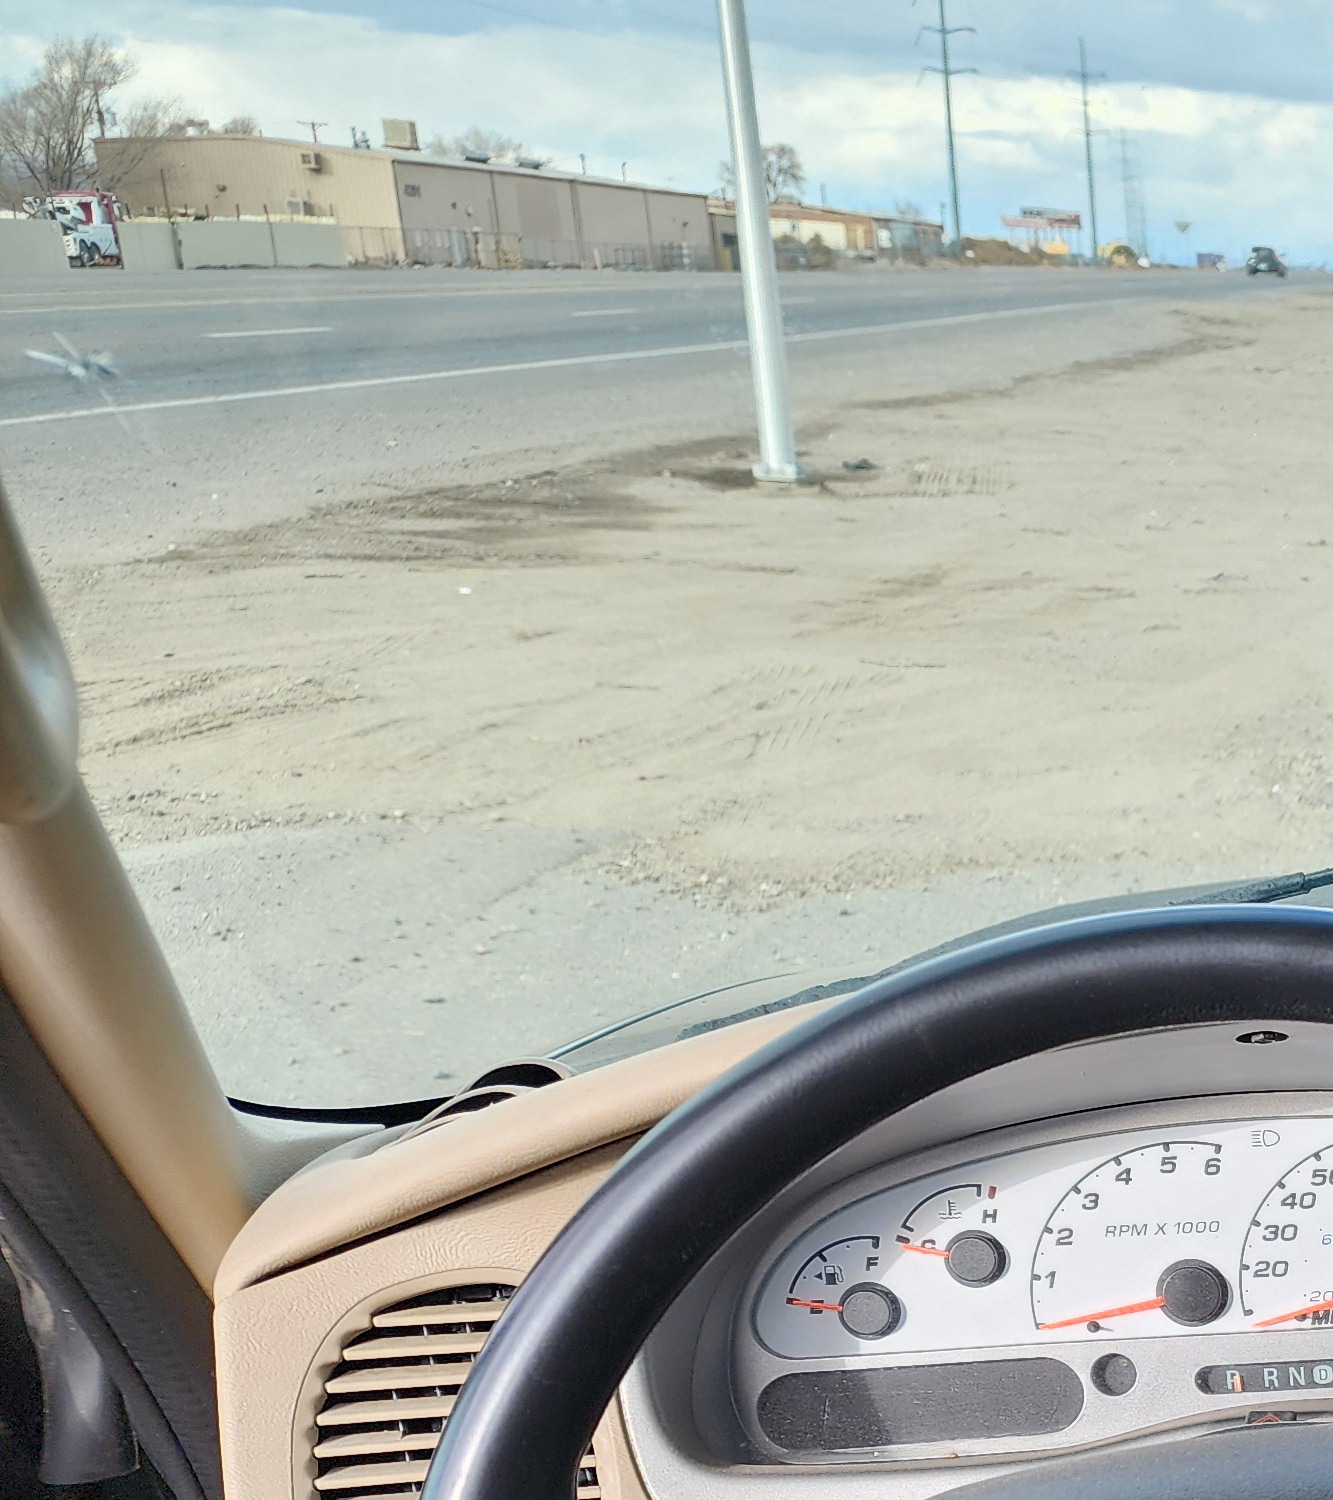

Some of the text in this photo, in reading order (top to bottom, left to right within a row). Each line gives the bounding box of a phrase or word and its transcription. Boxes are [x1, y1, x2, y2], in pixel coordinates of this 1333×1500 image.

[1160, 1156, 1177, 1173] 5
[1204, 1158, 1221, 1175] 6
[1115, 1168, 1132, 1185] 4
[1082, 1193, 1100, 1210] 3
[1280, 1192, 1316, 1209] 40
[982, 1209, 998, 1223] H
[1055, 1228, 1074, 1246] 2
[1105, 1220, 1220, 1238] RPM X 1000
[1262, 1224, 1298, 1241] 30
[866, 1257, 879, 1271] F
[1253, 1261, 1289, 1278] 20
[1045, 1271, 1056, 1288] 1
[1264, 1367, 1279, 1388] R
[1289, 1366, 1305, 1386] N
